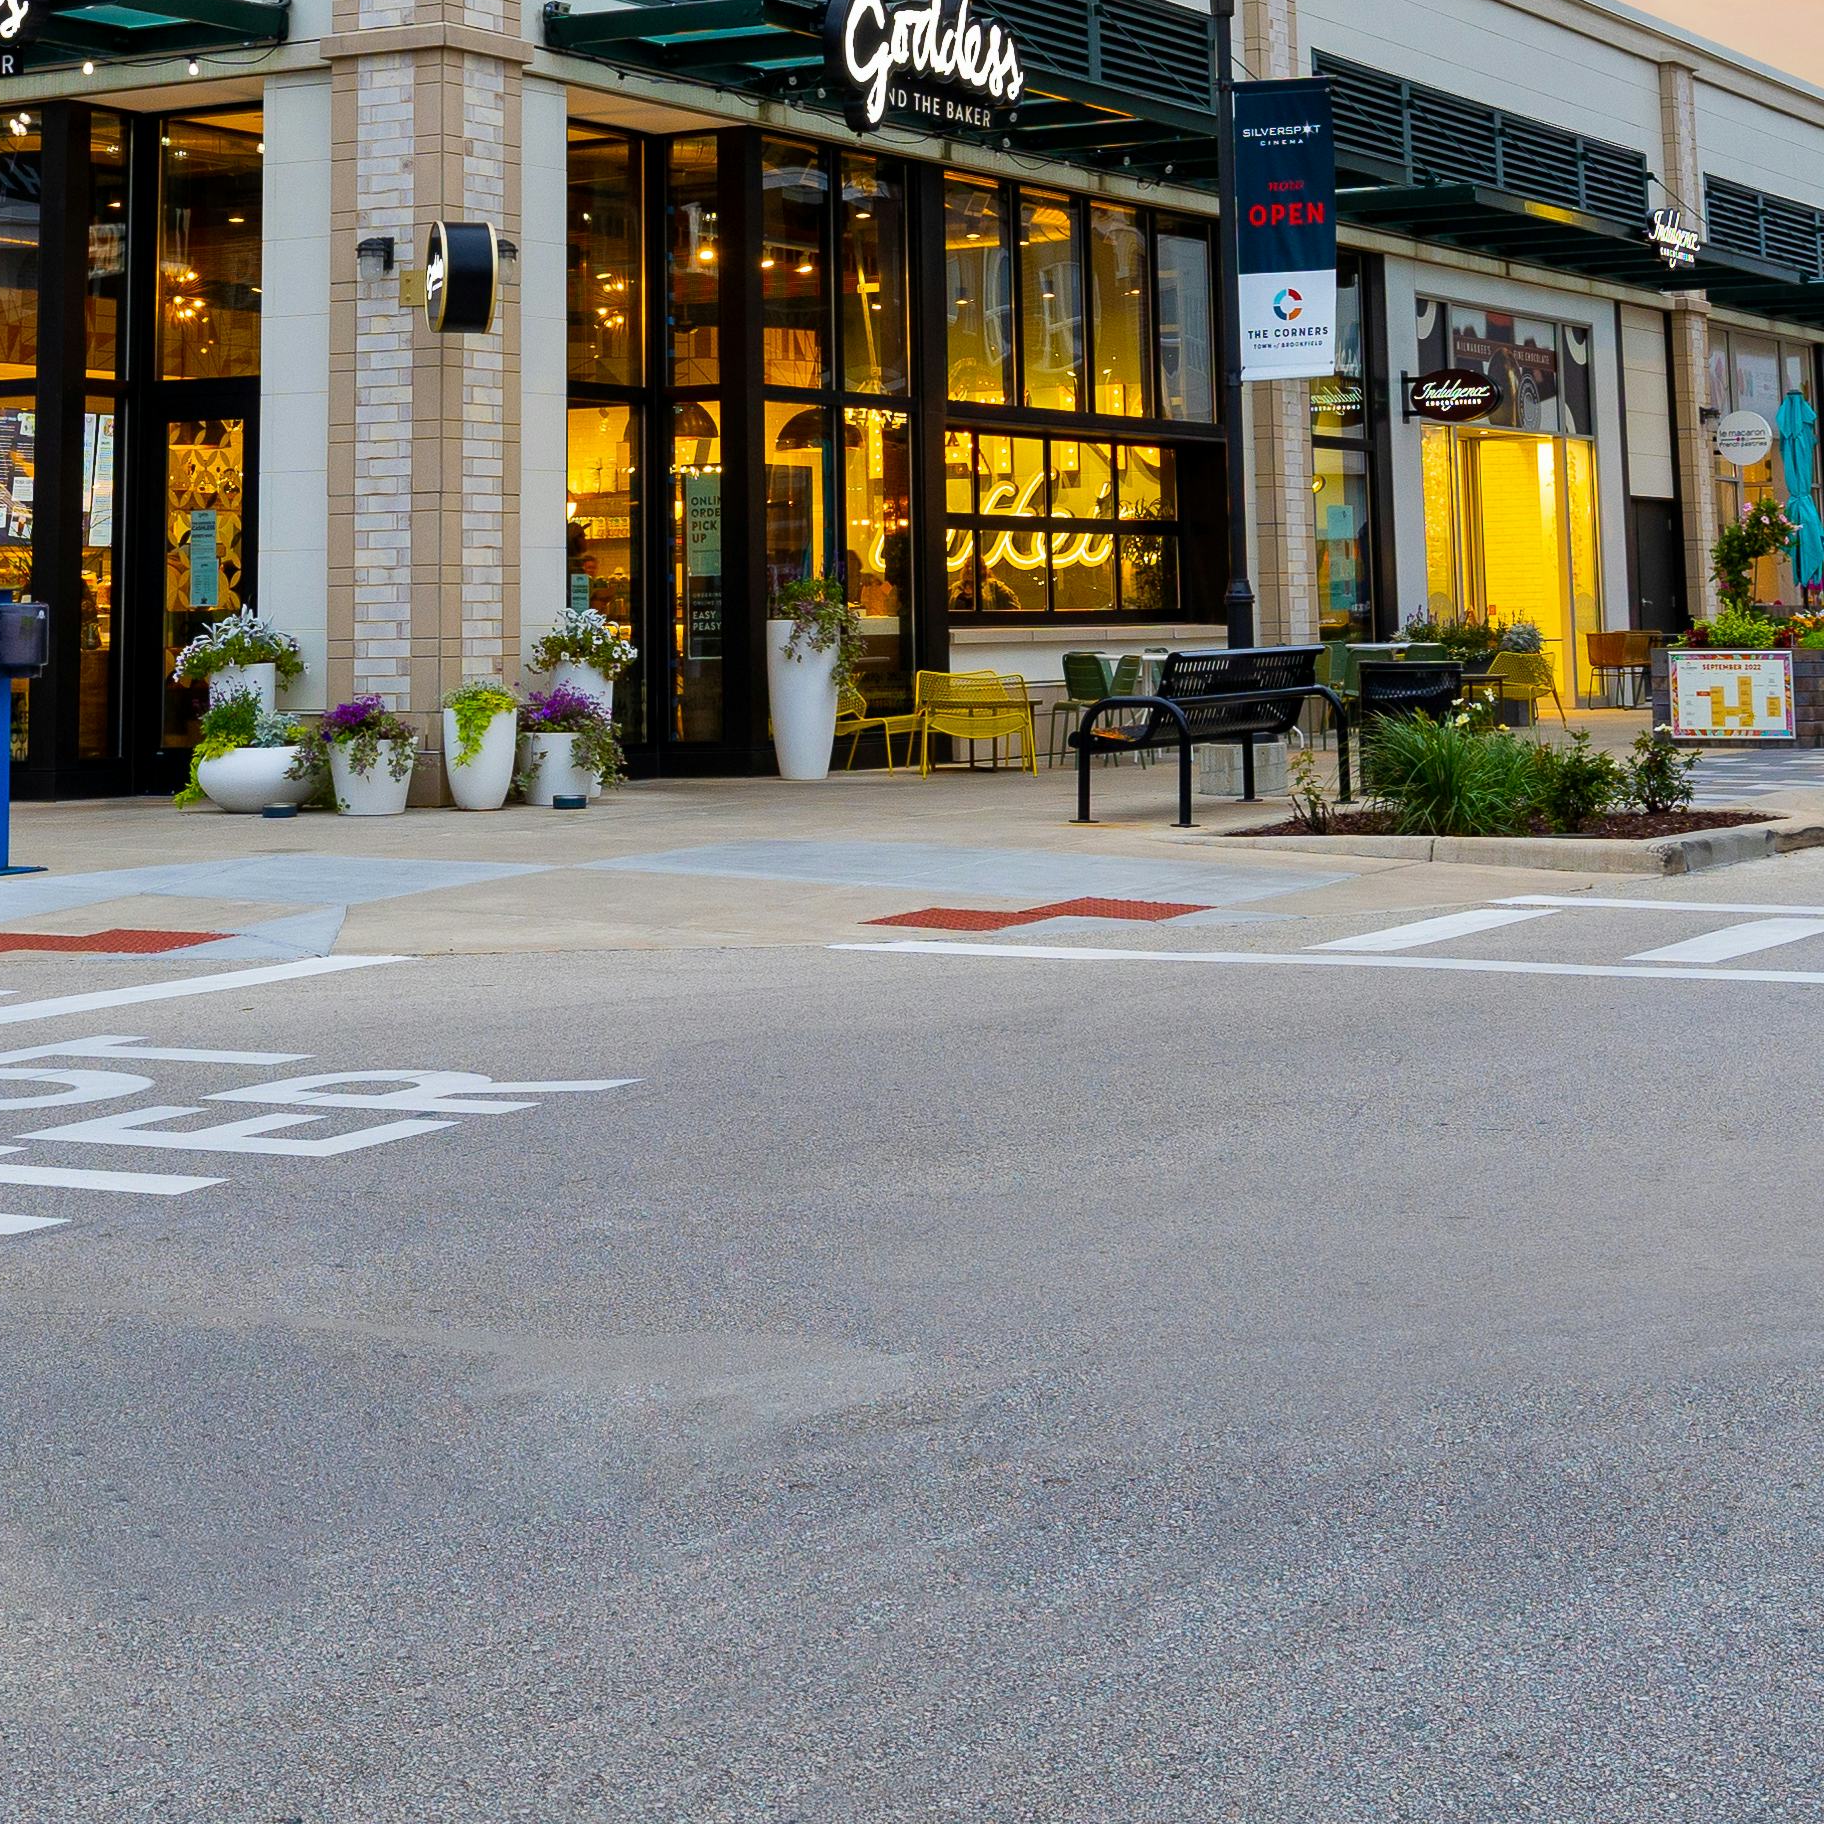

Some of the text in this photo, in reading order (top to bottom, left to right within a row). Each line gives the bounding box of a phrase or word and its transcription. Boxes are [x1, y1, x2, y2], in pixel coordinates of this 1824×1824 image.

[889, 87, 991, 128] ND THE BAKER
[1268, 180, 1305, 192] now
[1249, 202, 1325, 227] OPEN
[1248, 327, 1329, 339] THE CORNERS
[1414, 378, 1490, 411] Indulgence
[1728, 429, 1766, 437] macaron
[691, 496, 721, 506] ONLI
[691, 507, 721, 518] ORDE
[692, 521, 717, 531] PICK
[692, 534, 707, 543] UP
[692, 611, 717, 620] EASY
[692, 622, 722, 631] PEASY
[1702, 663, 1742, 671] SEPTEMBER
